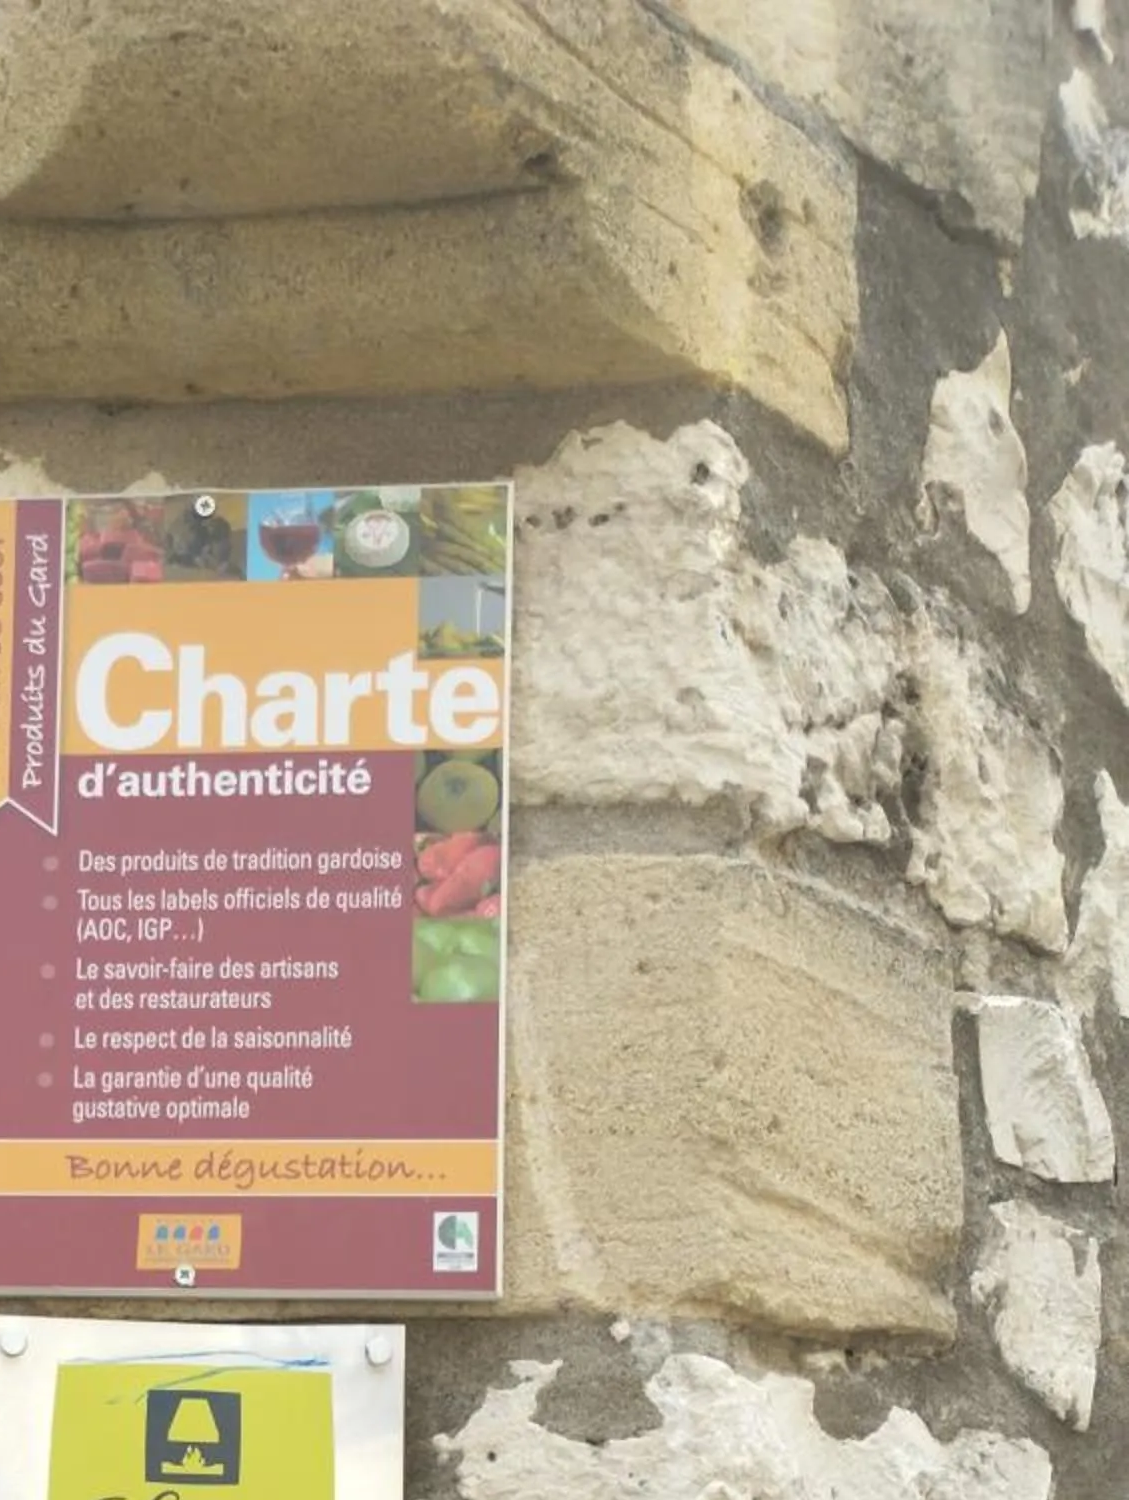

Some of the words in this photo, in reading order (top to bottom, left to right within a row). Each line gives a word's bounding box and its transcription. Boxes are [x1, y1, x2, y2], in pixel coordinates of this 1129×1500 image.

[26, 533, 51, 607] Gard
[22, 615, 47, 655] du
[76, 632, 500, 750] Charte
[20, 664, 46, 789] Produits
[78, 759, 371, 799] d'authenticité
[79, 850, 116, 872] Des
[121, 849, 199, 876] produits
[204, 848, 227, 871] de
[232, 848, 312, 870] tradition
[318, 847, 402, 874] gardoise
[77, 888, 122, 911] Tous
[128, 888, 155, 910] les
[161, 888, 218, 910] labels
[224, 887, 300, 910] officiels
[306, 886, 329, 909] de
[336, 885, 402, 912] qualité
[77, 917, 131, 943] (AOC,
[76, 957, 99, 980] Le
[104, 956, 214, 980] savoir-faire
[220, 955, 254, 979] des
[260, 956, 339, 979] artisans
[75, 990, 93, 1009] et
[99, 988, 134, 1009] des
[139, 990, 272, 1009] restaurateurs
[75, 1027, 97, 1048] Le
[102, 1029, 177, 1053] respect
[182, 1026, 205, 1048] de
[211, 1026, 228, 1048] la
[234, 1025, 352, 1048] saisonnalité
[73, 1066, 95, 1088] La
[101, 1066, 181, 1092] garantie
[187, 1065, 241, 1088] d'une
[246, 1065, 313, 1094] qualité
[72, 1097, 160, 1123] gustative
[166, 1096, 250, 1123] optimale
[66, 1154, 183, 1181] Bonne
[194, 1148, 446, 1190] dégustation...
